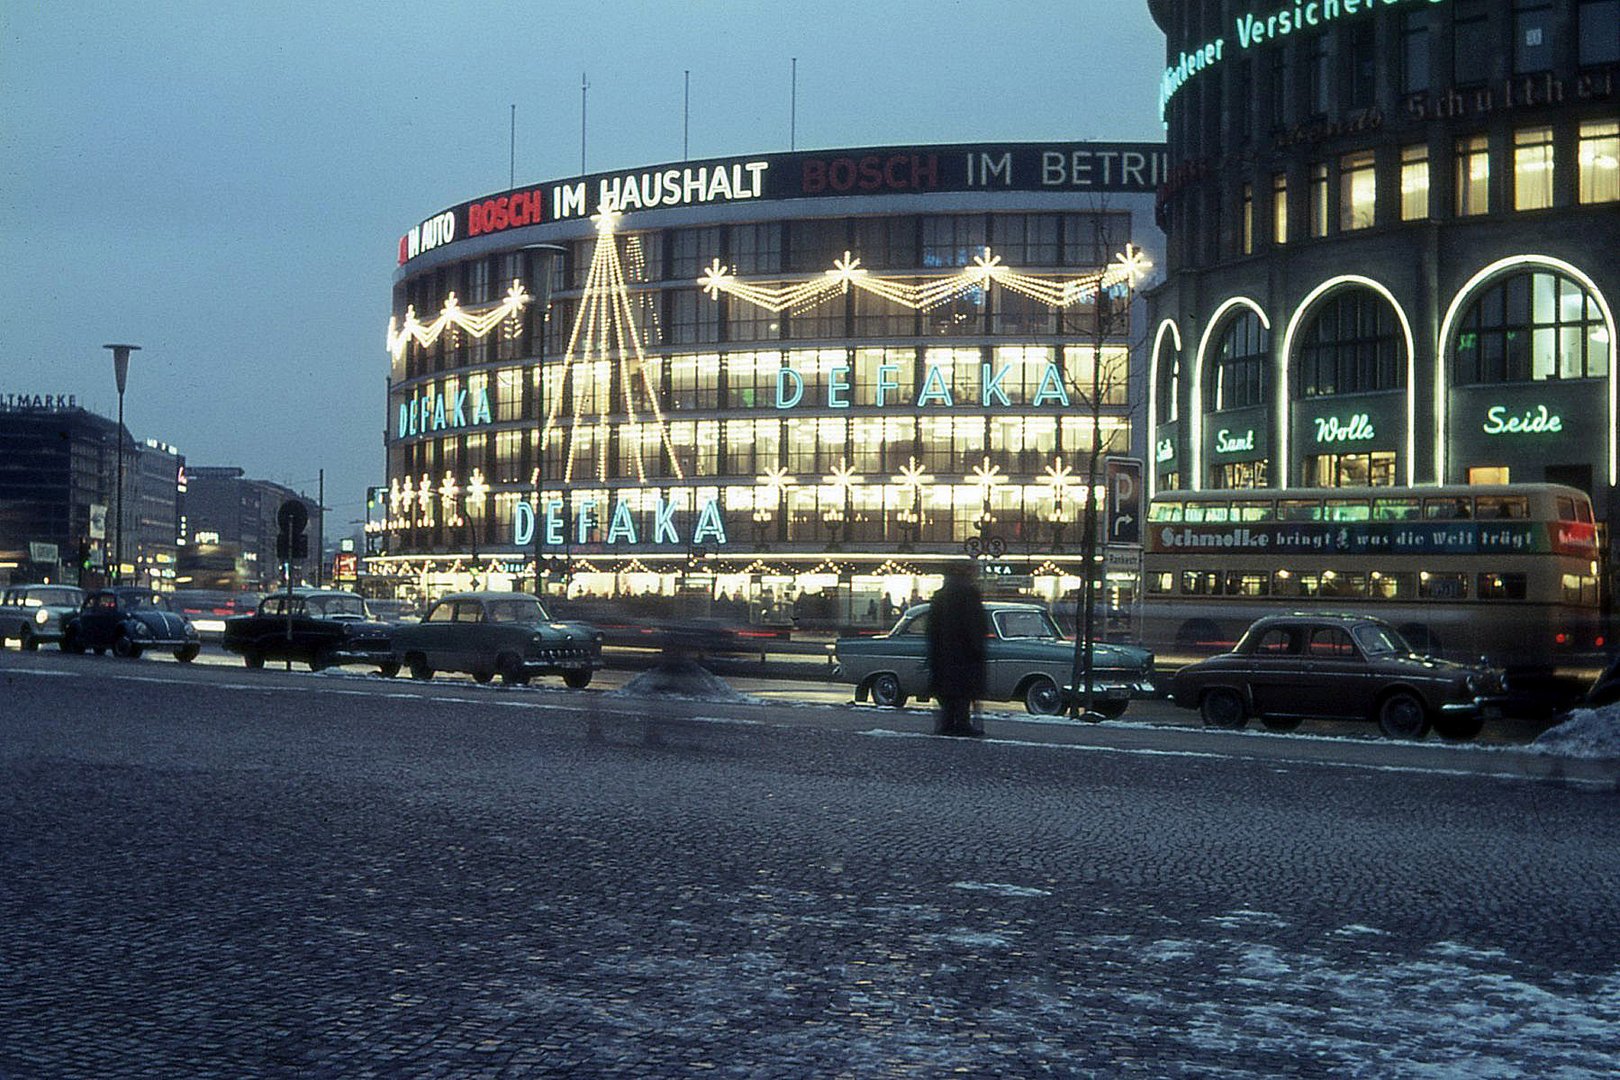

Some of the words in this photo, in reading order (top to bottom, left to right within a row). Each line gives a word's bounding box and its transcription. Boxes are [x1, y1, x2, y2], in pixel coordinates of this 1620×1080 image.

[421, 211, 455, 253] AUTO
[468, 189, 541, 236] BOSCH
[553, 182, 586, 219] IM
[600, 162, 768, 212] HAUSHALT
[802, 153, 938, 193] BOSCH
[967, 152, 1012, 186] IM
[776, 362, 1069, 409] DEFAKA
[399, 386, 492, 439] DEFAKA
[1314, 413, 1376, 442] Wolle
[1483, 404, 1562, 434] Seide
[1216, 429, 1254, 453] Samt
[1115, 473, 1133, 513] P
[514, 498, 726, 545] DEFAKA
[1161, 527, 1269, 547] Schmolke
[1397, 531, 1424, 545] die
